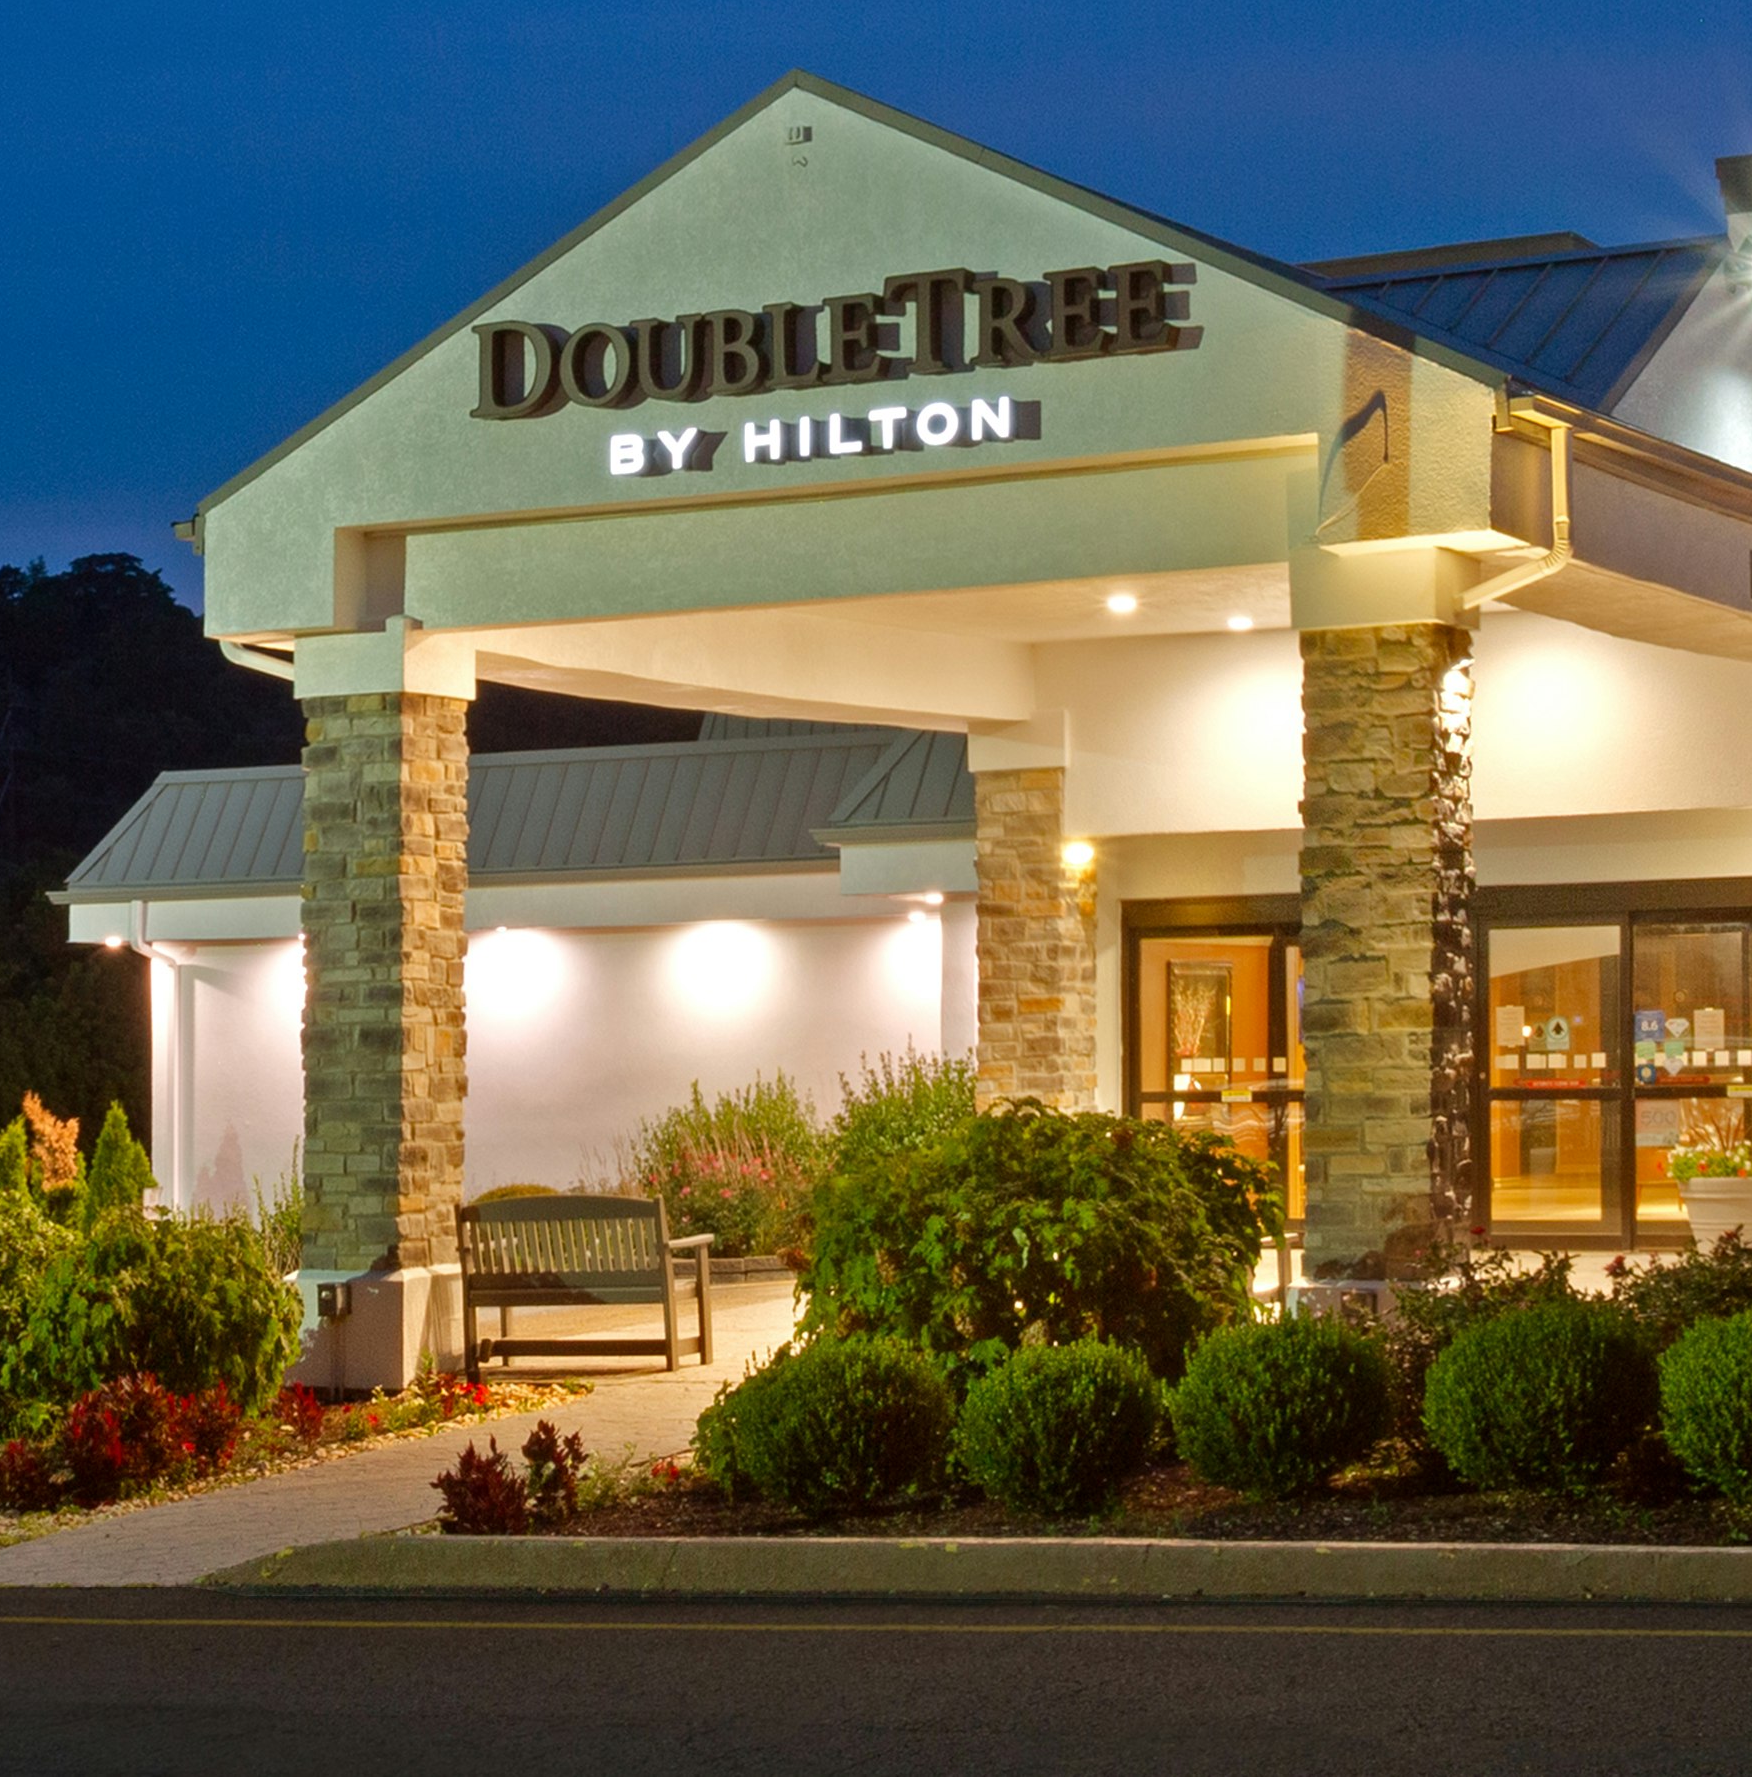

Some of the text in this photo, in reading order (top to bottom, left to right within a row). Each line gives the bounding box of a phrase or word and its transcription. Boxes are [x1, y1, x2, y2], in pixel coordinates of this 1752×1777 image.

[469, 260, 1181, 420] DOUBLETREE
[610, 396, 1013, 476] BY HILTON
[1641, 1020, 1659, 1032] 8.6
